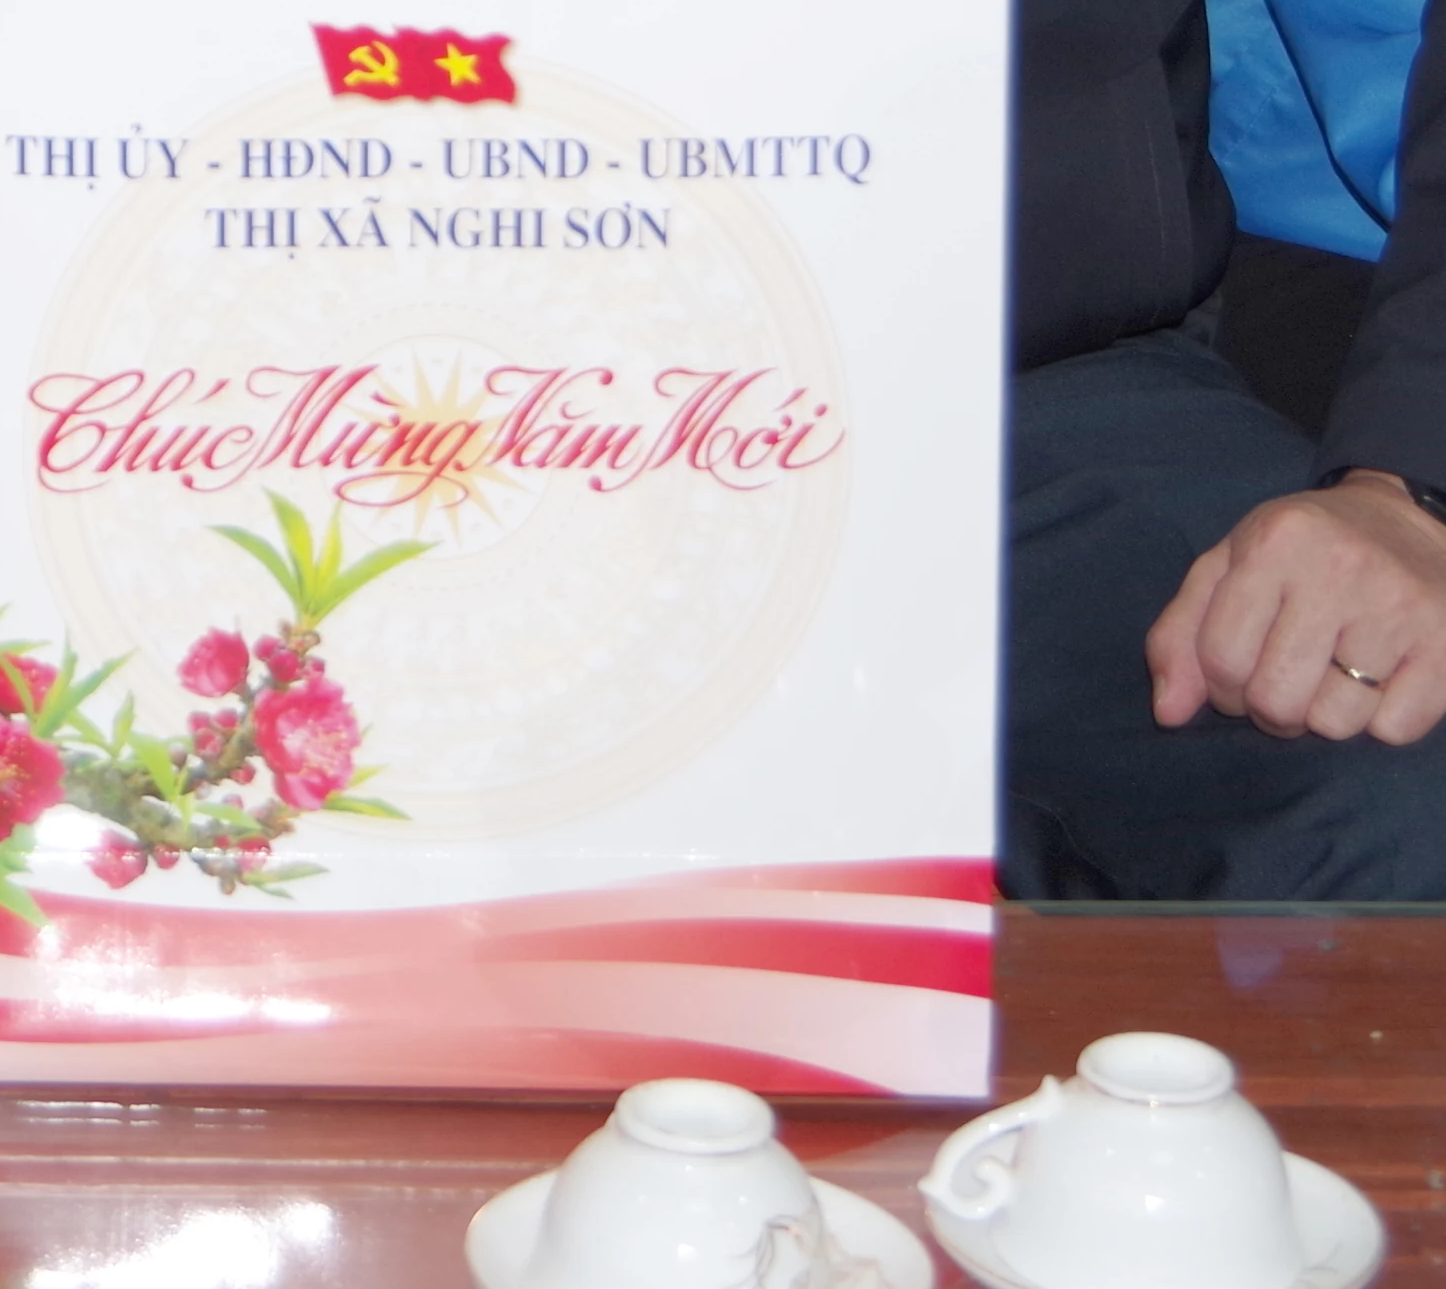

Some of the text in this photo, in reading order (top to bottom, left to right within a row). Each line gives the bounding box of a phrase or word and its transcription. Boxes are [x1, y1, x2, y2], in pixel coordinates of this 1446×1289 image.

[5, 134, 100, 191] THỊ
[117, 123, 189, 179] ỦY
[238, 137, 392, 179] HĐND
[442, 137, 590, 179] UBND
[638, 133, 872, 186] UBMTTQ
[204, 195, 670, 260] THỊ XÃ NGHI SƠN
[27, 365, 846, 508] Chúc Mừng Năm Mới
